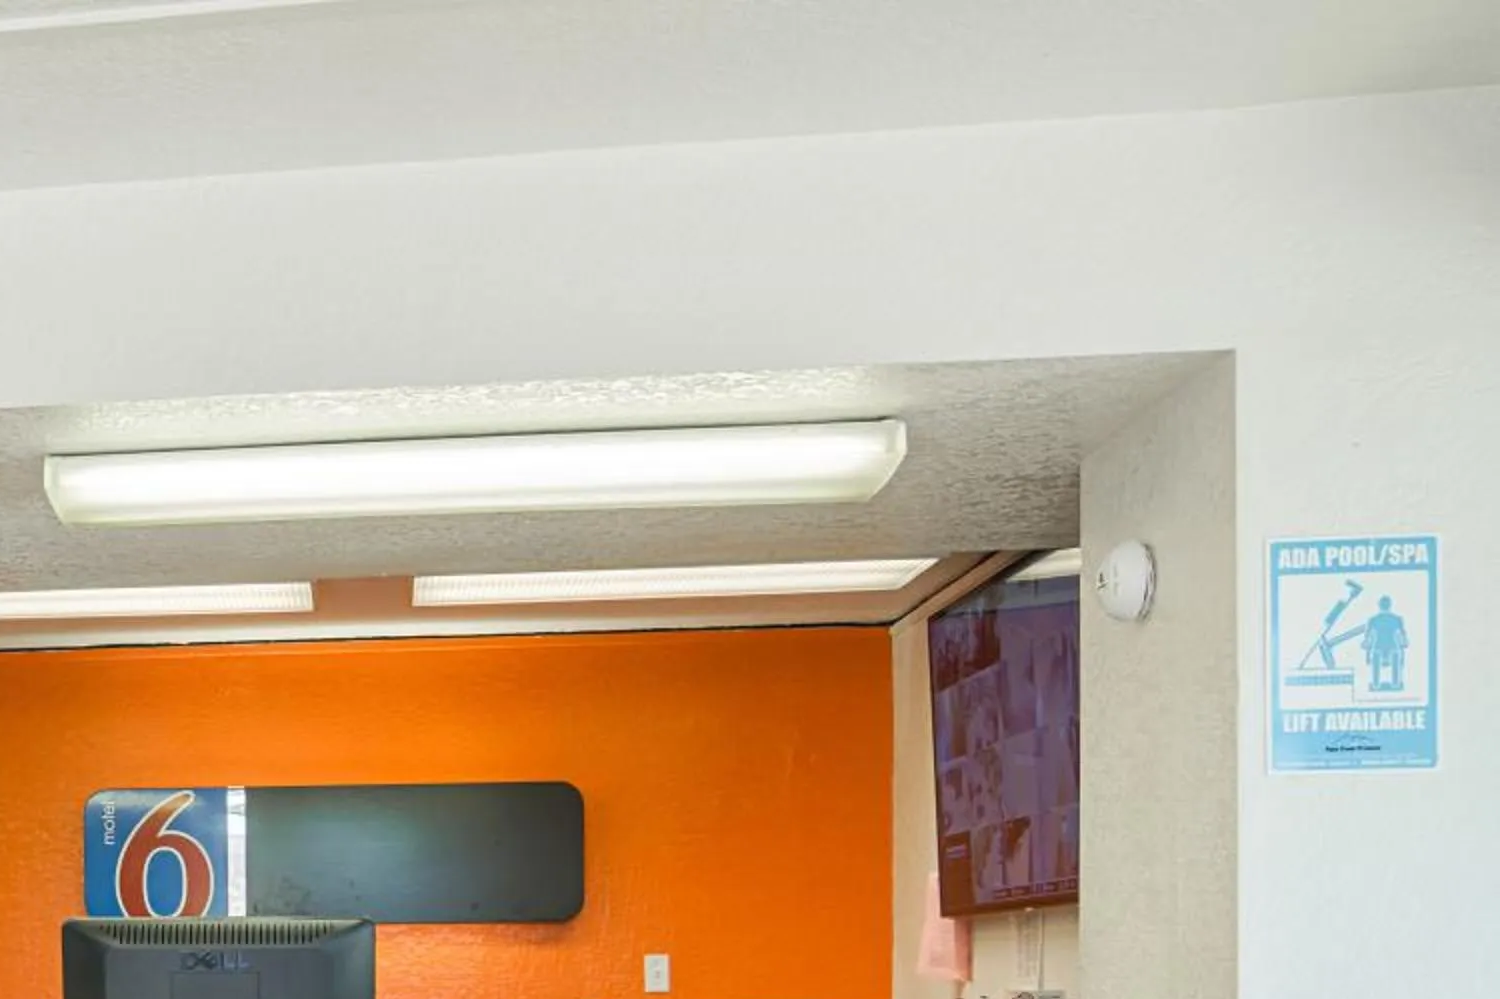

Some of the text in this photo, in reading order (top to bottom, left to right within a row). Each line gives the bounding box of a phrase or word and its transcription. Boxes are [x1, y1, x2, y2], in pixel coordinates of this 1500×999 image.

[1279, 543, 1429, 569] ADA POOL/SPA
[1283, 710, 1427, 733] LIFT AVAILABLE
[101, 790, 214, 918] motel 6
[181, 951, 248, 971] DELL
